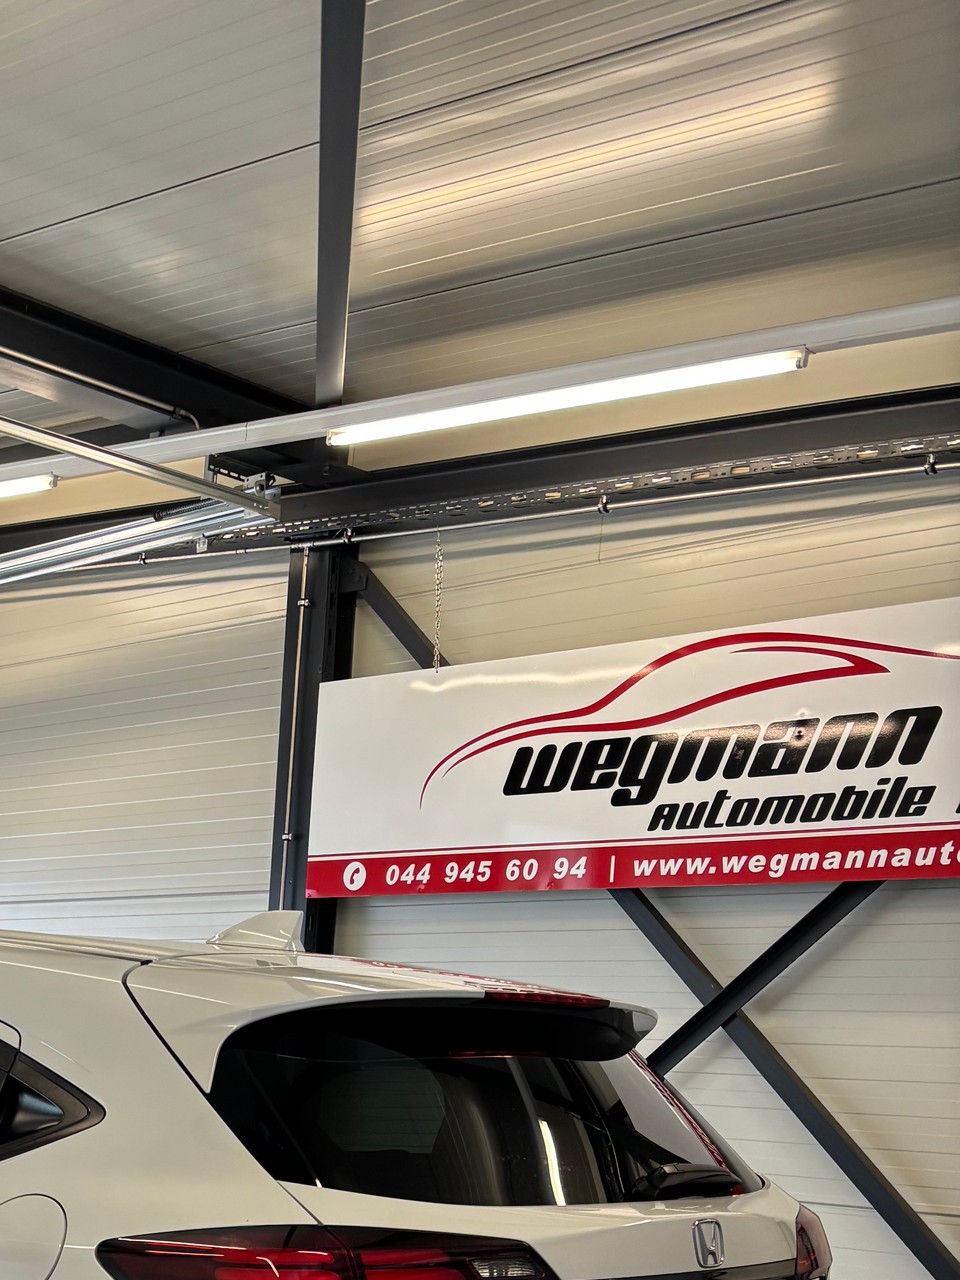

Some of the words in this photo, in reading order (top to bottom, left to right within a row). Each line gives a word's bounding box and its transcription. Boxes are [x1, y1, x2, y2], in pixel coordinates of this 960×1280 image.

[502, 705, 943, 807] wegmann
[385, 863, 431, 886] 044
[444, 860, 492, 884] 945
[505, 858, 539, 882] 60
[552, 856, 588, 880] 94
[632, 840, 960, 879] www.wegmannaut
